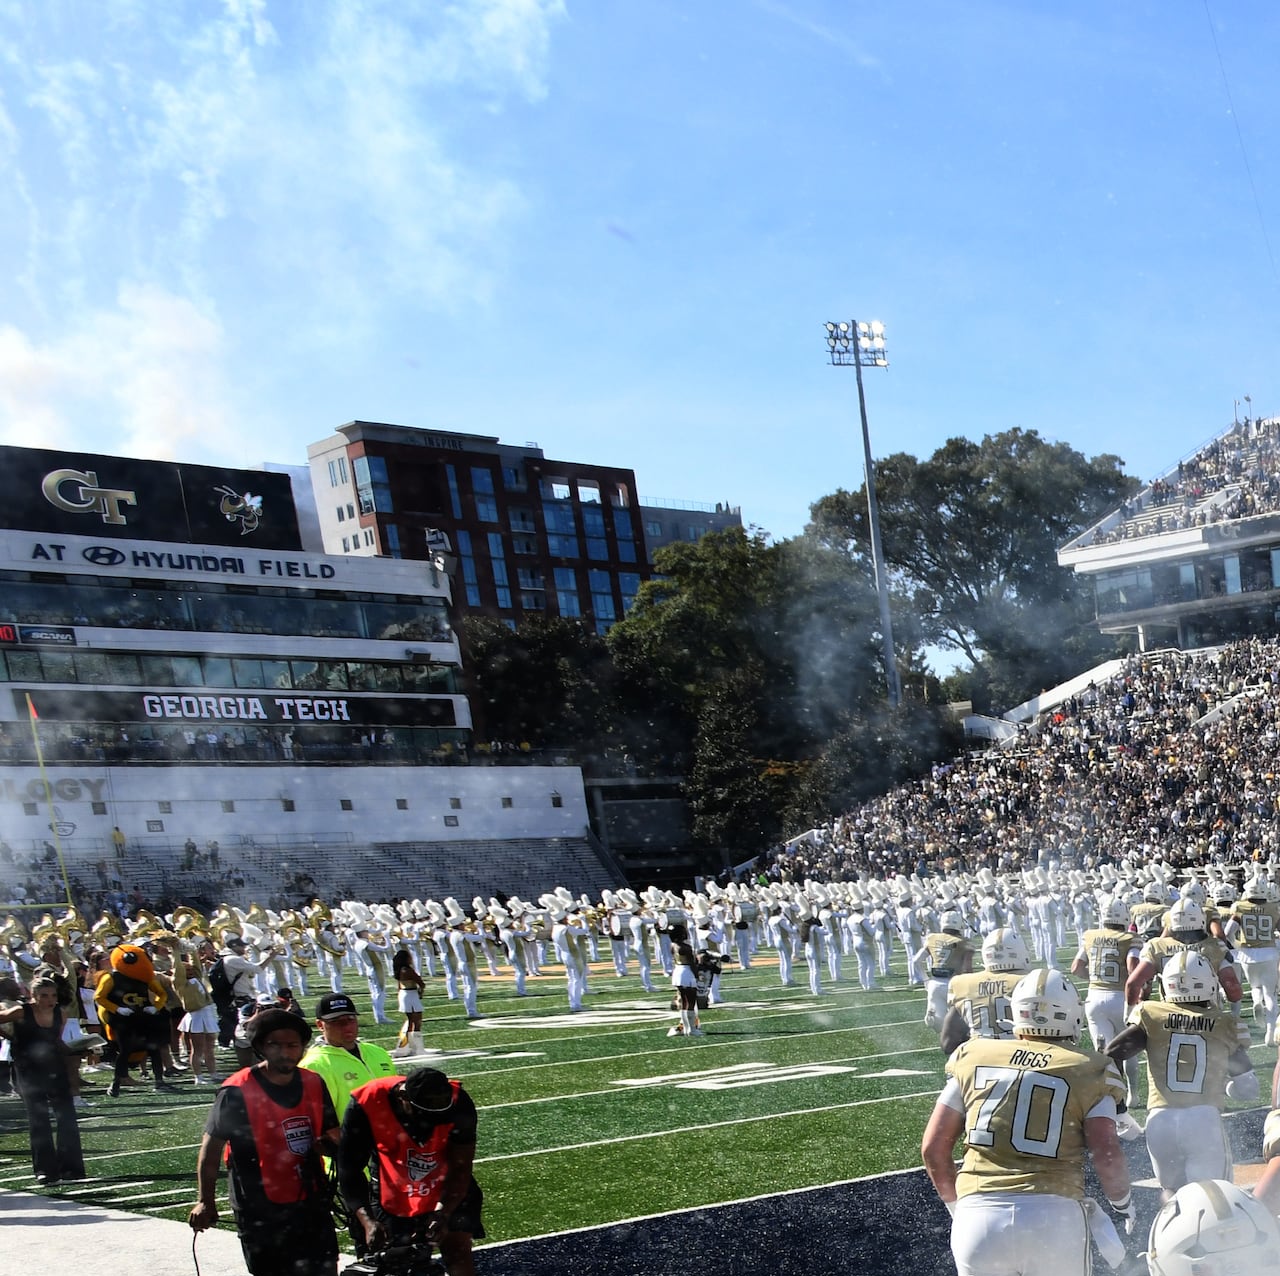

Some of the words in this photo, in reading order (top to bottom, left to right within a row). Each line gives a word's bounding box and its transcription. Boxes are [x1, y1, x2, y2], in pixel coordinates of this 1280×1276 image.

[424, 436, 464, 450] INSPIRE
[42, 469, 138, 526] GT
[32, 543, 67, 562] AT
[132, 550, 245, 575] HYUNDAI
[259, 559, 336, 579] FIELD
[143, 695, 268, 720] GEORGIA
[274, 698, 351, 721] TECH
[0, 777, 107, 802] LOGY
[1242, 914, 1274, 941] 69
[1090, 946, 1121, 983] 16
[978, 980, 1008, 996] OKOYE
[1009, 1048, 1052, 1070] RIGGS
[1166, 1032, 1208, 1096] 0
[968, 1065, 1071, 1159] 70
